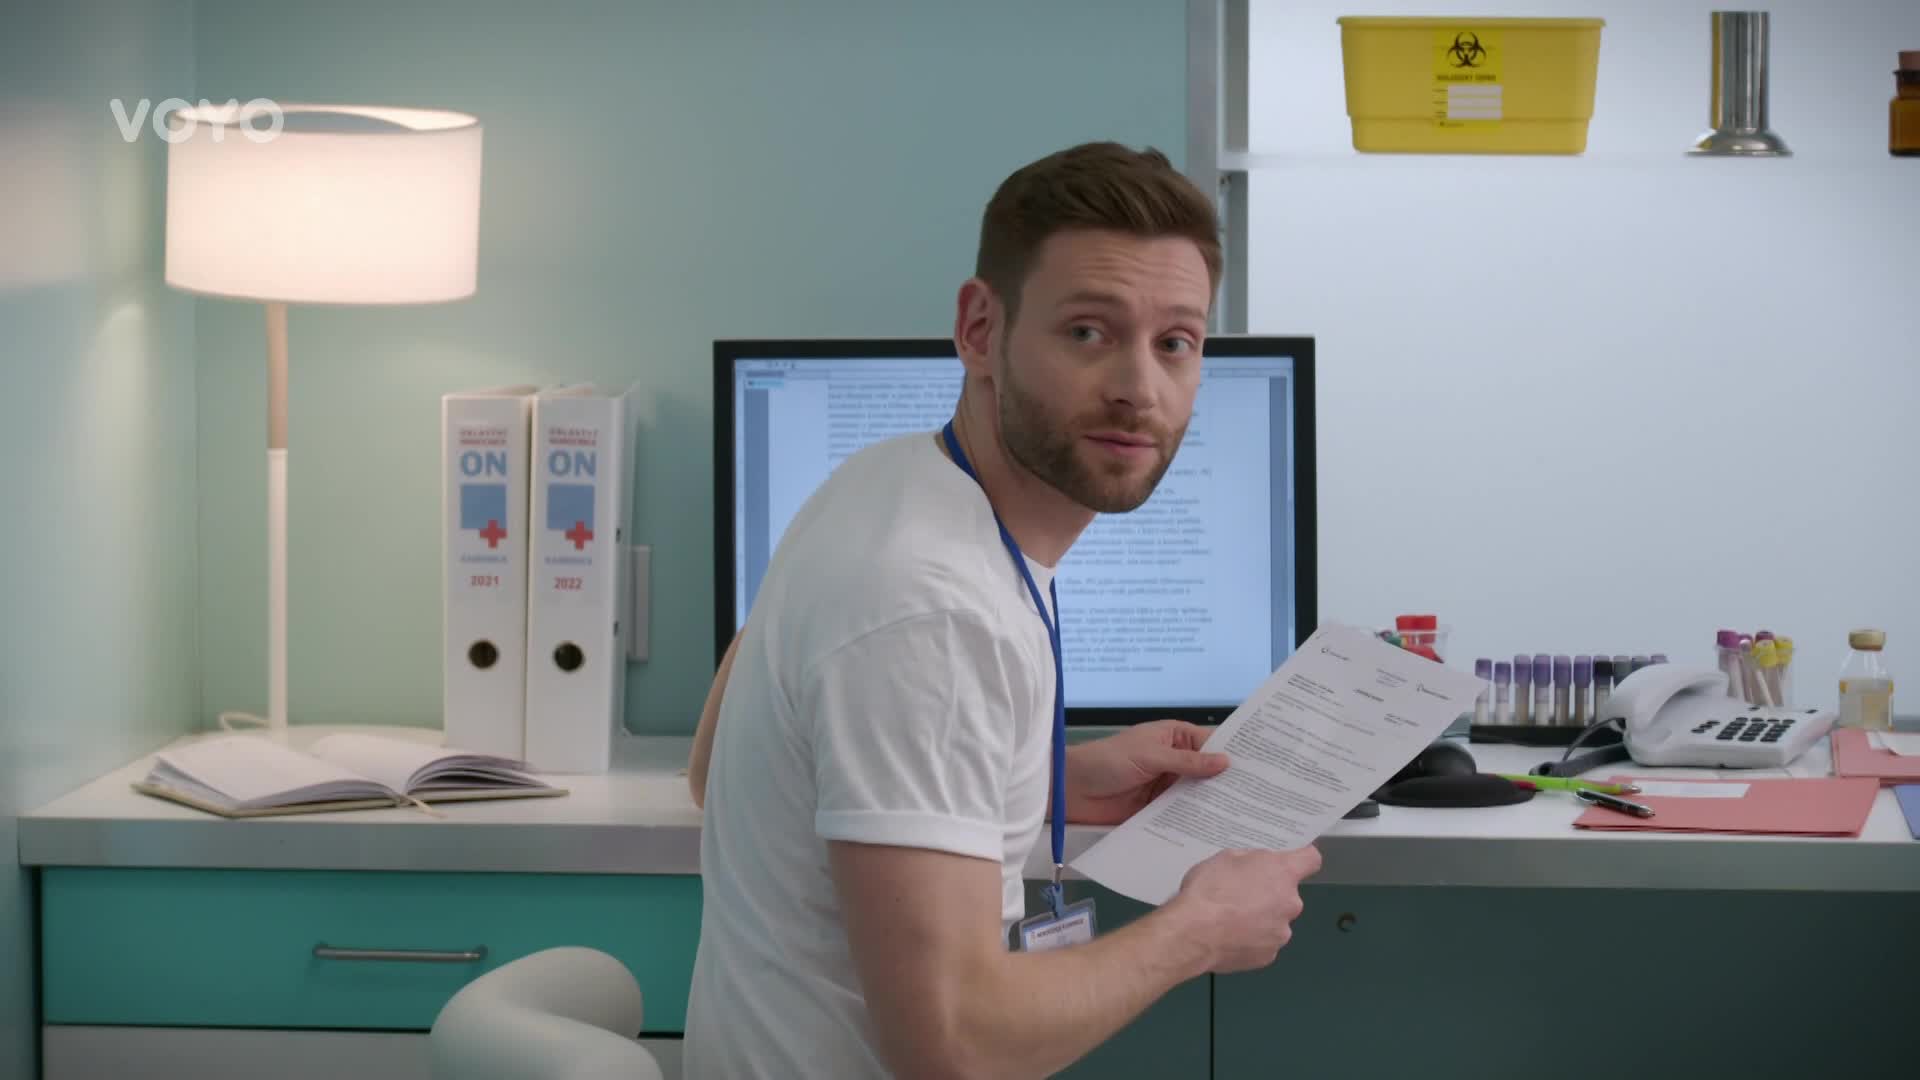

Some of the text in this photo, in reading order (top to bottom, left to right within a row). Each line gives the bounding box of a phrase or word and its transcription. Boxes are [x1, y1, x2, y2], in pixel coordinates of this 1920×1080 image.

[460, 450, 507, 477] ON
[548, 450, 596, 477] ON
[470, 575, 500, 587] 2021
[554, 576, 583, 590] 2022
